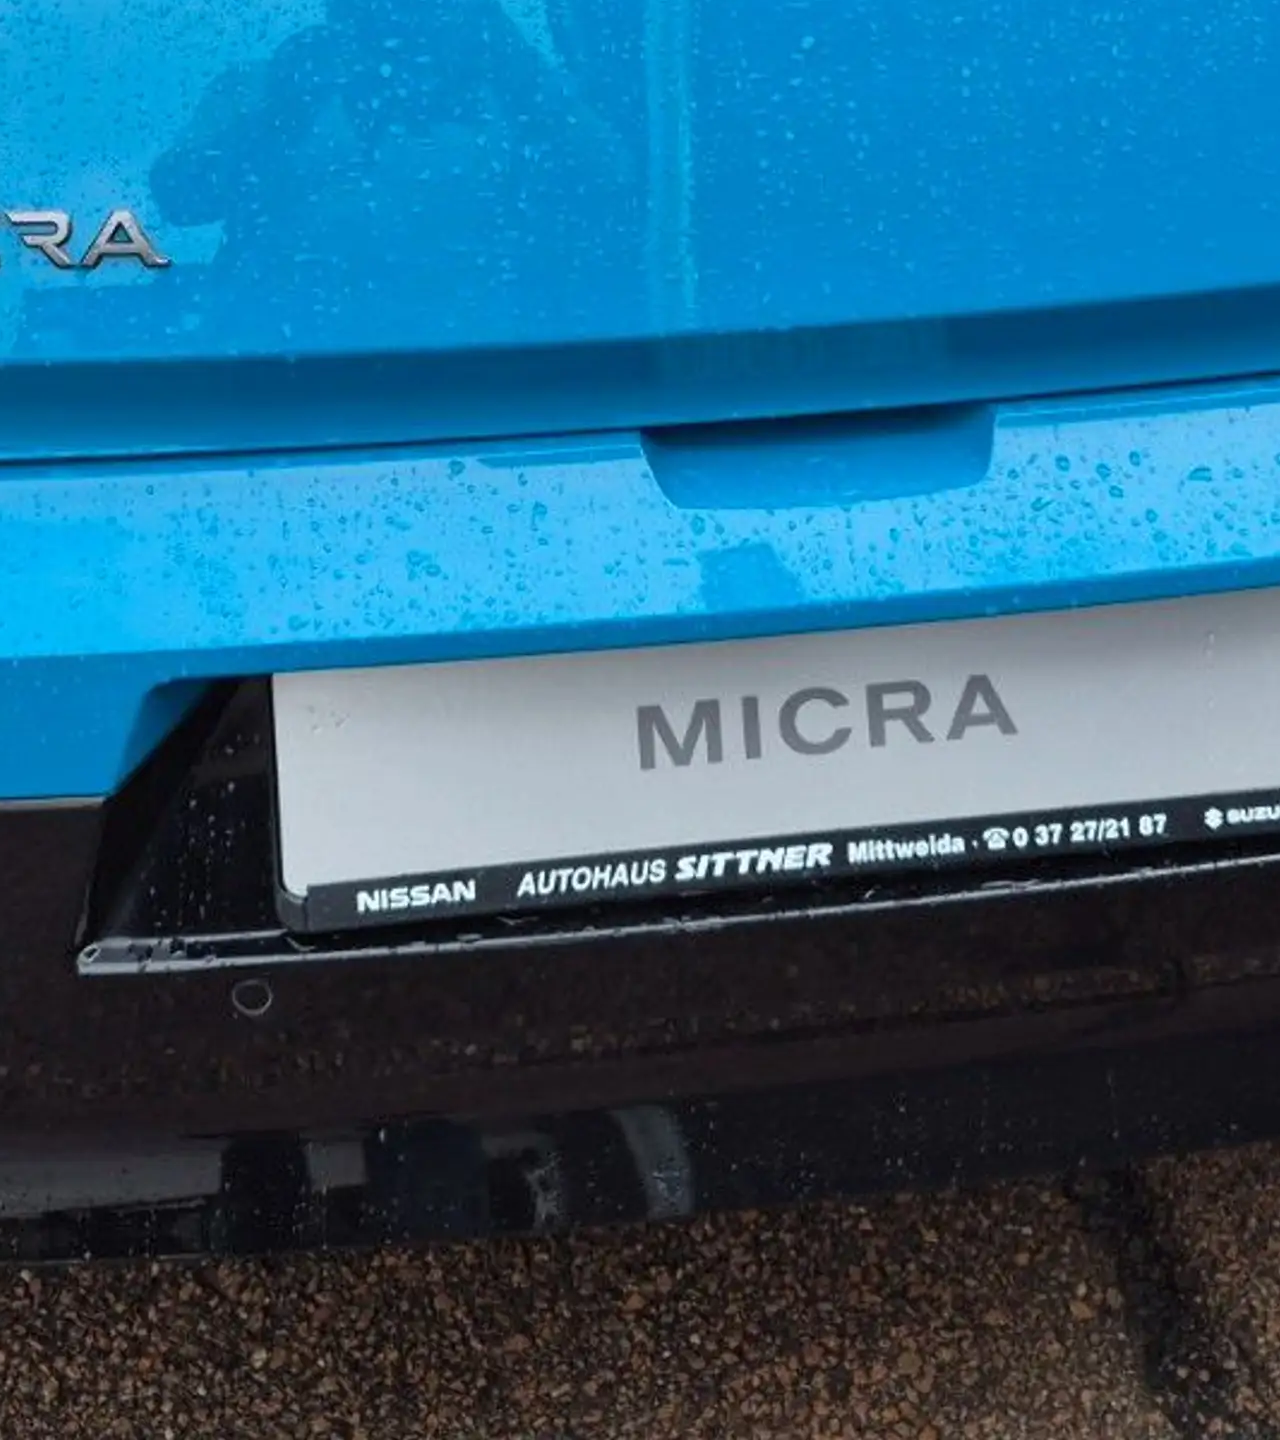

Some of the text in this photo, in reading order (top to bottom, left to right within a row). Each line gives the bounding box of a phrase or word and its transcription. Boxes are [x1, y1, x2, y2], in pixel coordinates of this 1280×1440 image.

[635, 673, 1019, 770] MICRA
[356, 879, 477, 913] NISSAN
[516, 859, 667, 897] AUTOHAUS
[675, 842, 834, 881] SITTNER
[847, 833, 966, 864] Mittweida
[1012, 825, 1029, 850] 0
[1035, 823, 1063, 847] 37
[1070, 817, 1130, 843] 27/21
